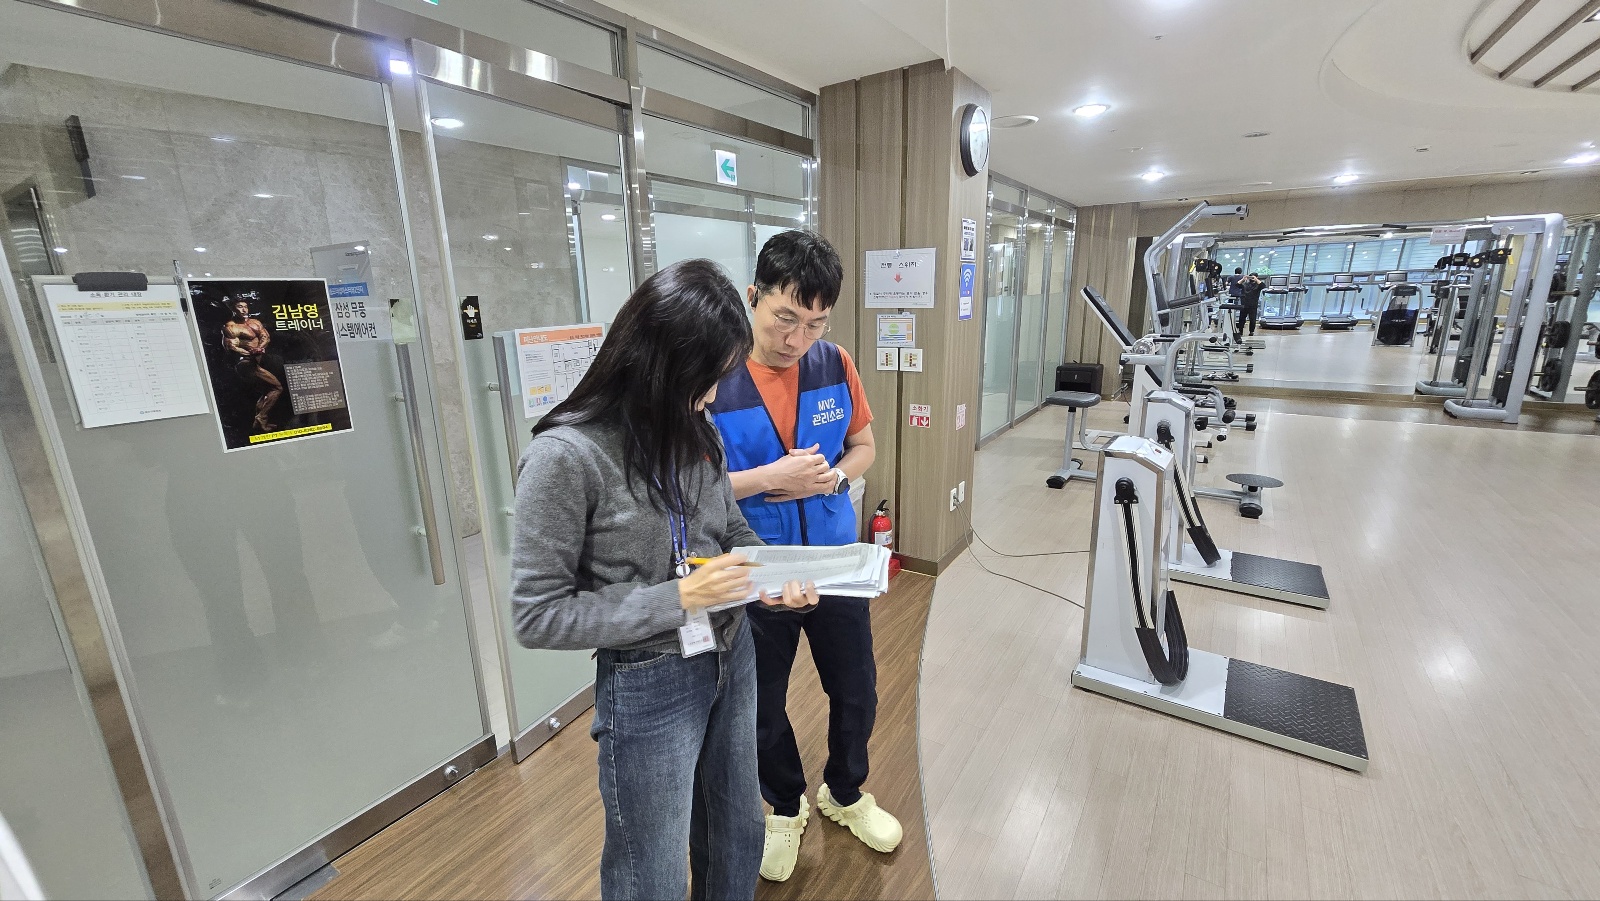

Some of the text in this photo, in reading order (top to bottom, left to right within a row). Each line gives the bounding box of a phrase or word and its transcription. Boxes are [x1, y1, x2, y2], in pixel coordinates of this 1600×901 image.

[271, 303, 319, 320] 김남영
[335, 301, 367, 319] 삼성 무풍
[275, 317, 324, 332] 트레이너
[817, 397, 836, 412] MV2
[812, 407, 845, 426] 관리소장
